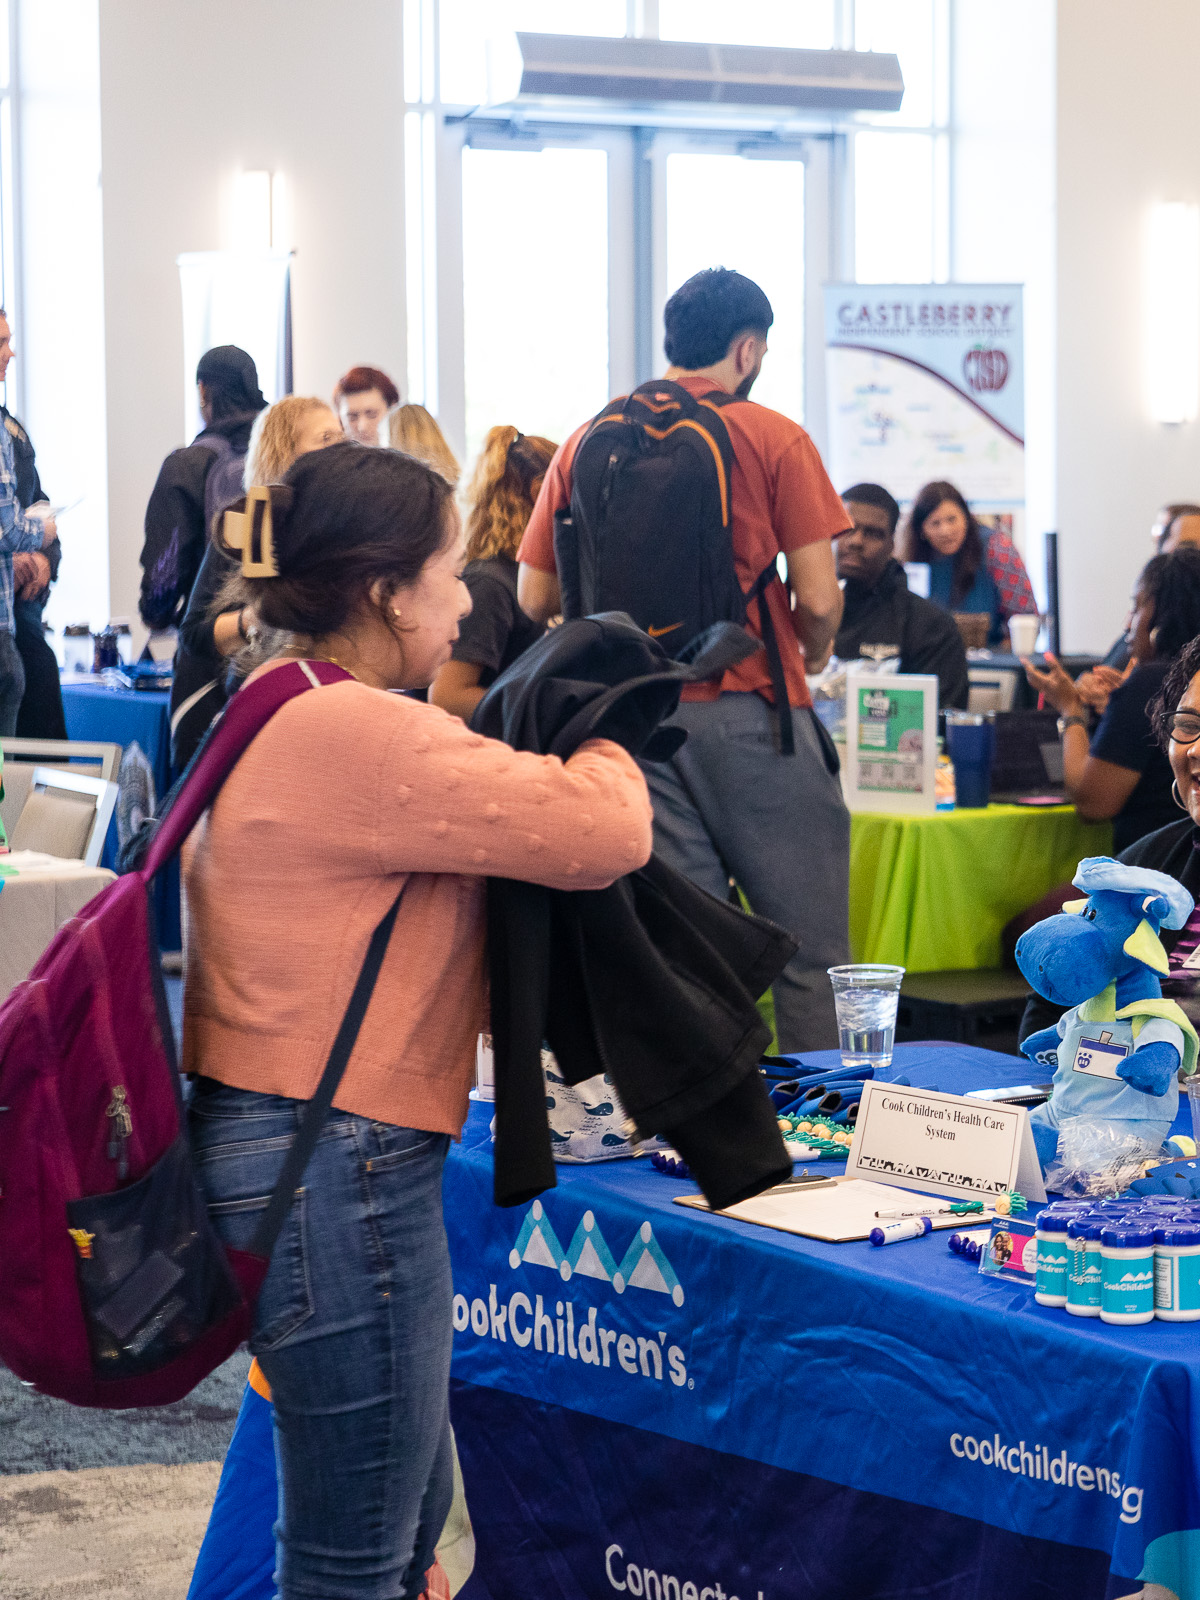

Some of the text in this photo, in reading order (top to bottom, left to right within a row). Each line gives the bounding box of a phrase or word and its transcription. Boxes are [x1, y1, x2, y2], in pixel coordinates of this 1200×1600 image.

[838, 302, 1014, 328] CASTLEBERRY
[881, 1097, 1005, 1131] Cook Children's Health Care
[925, 1124, 956, 1141] System
[452, 1283, 687, 1387] ookChildren's
[950, 1432, 1144, 1524] cookchildrensg
